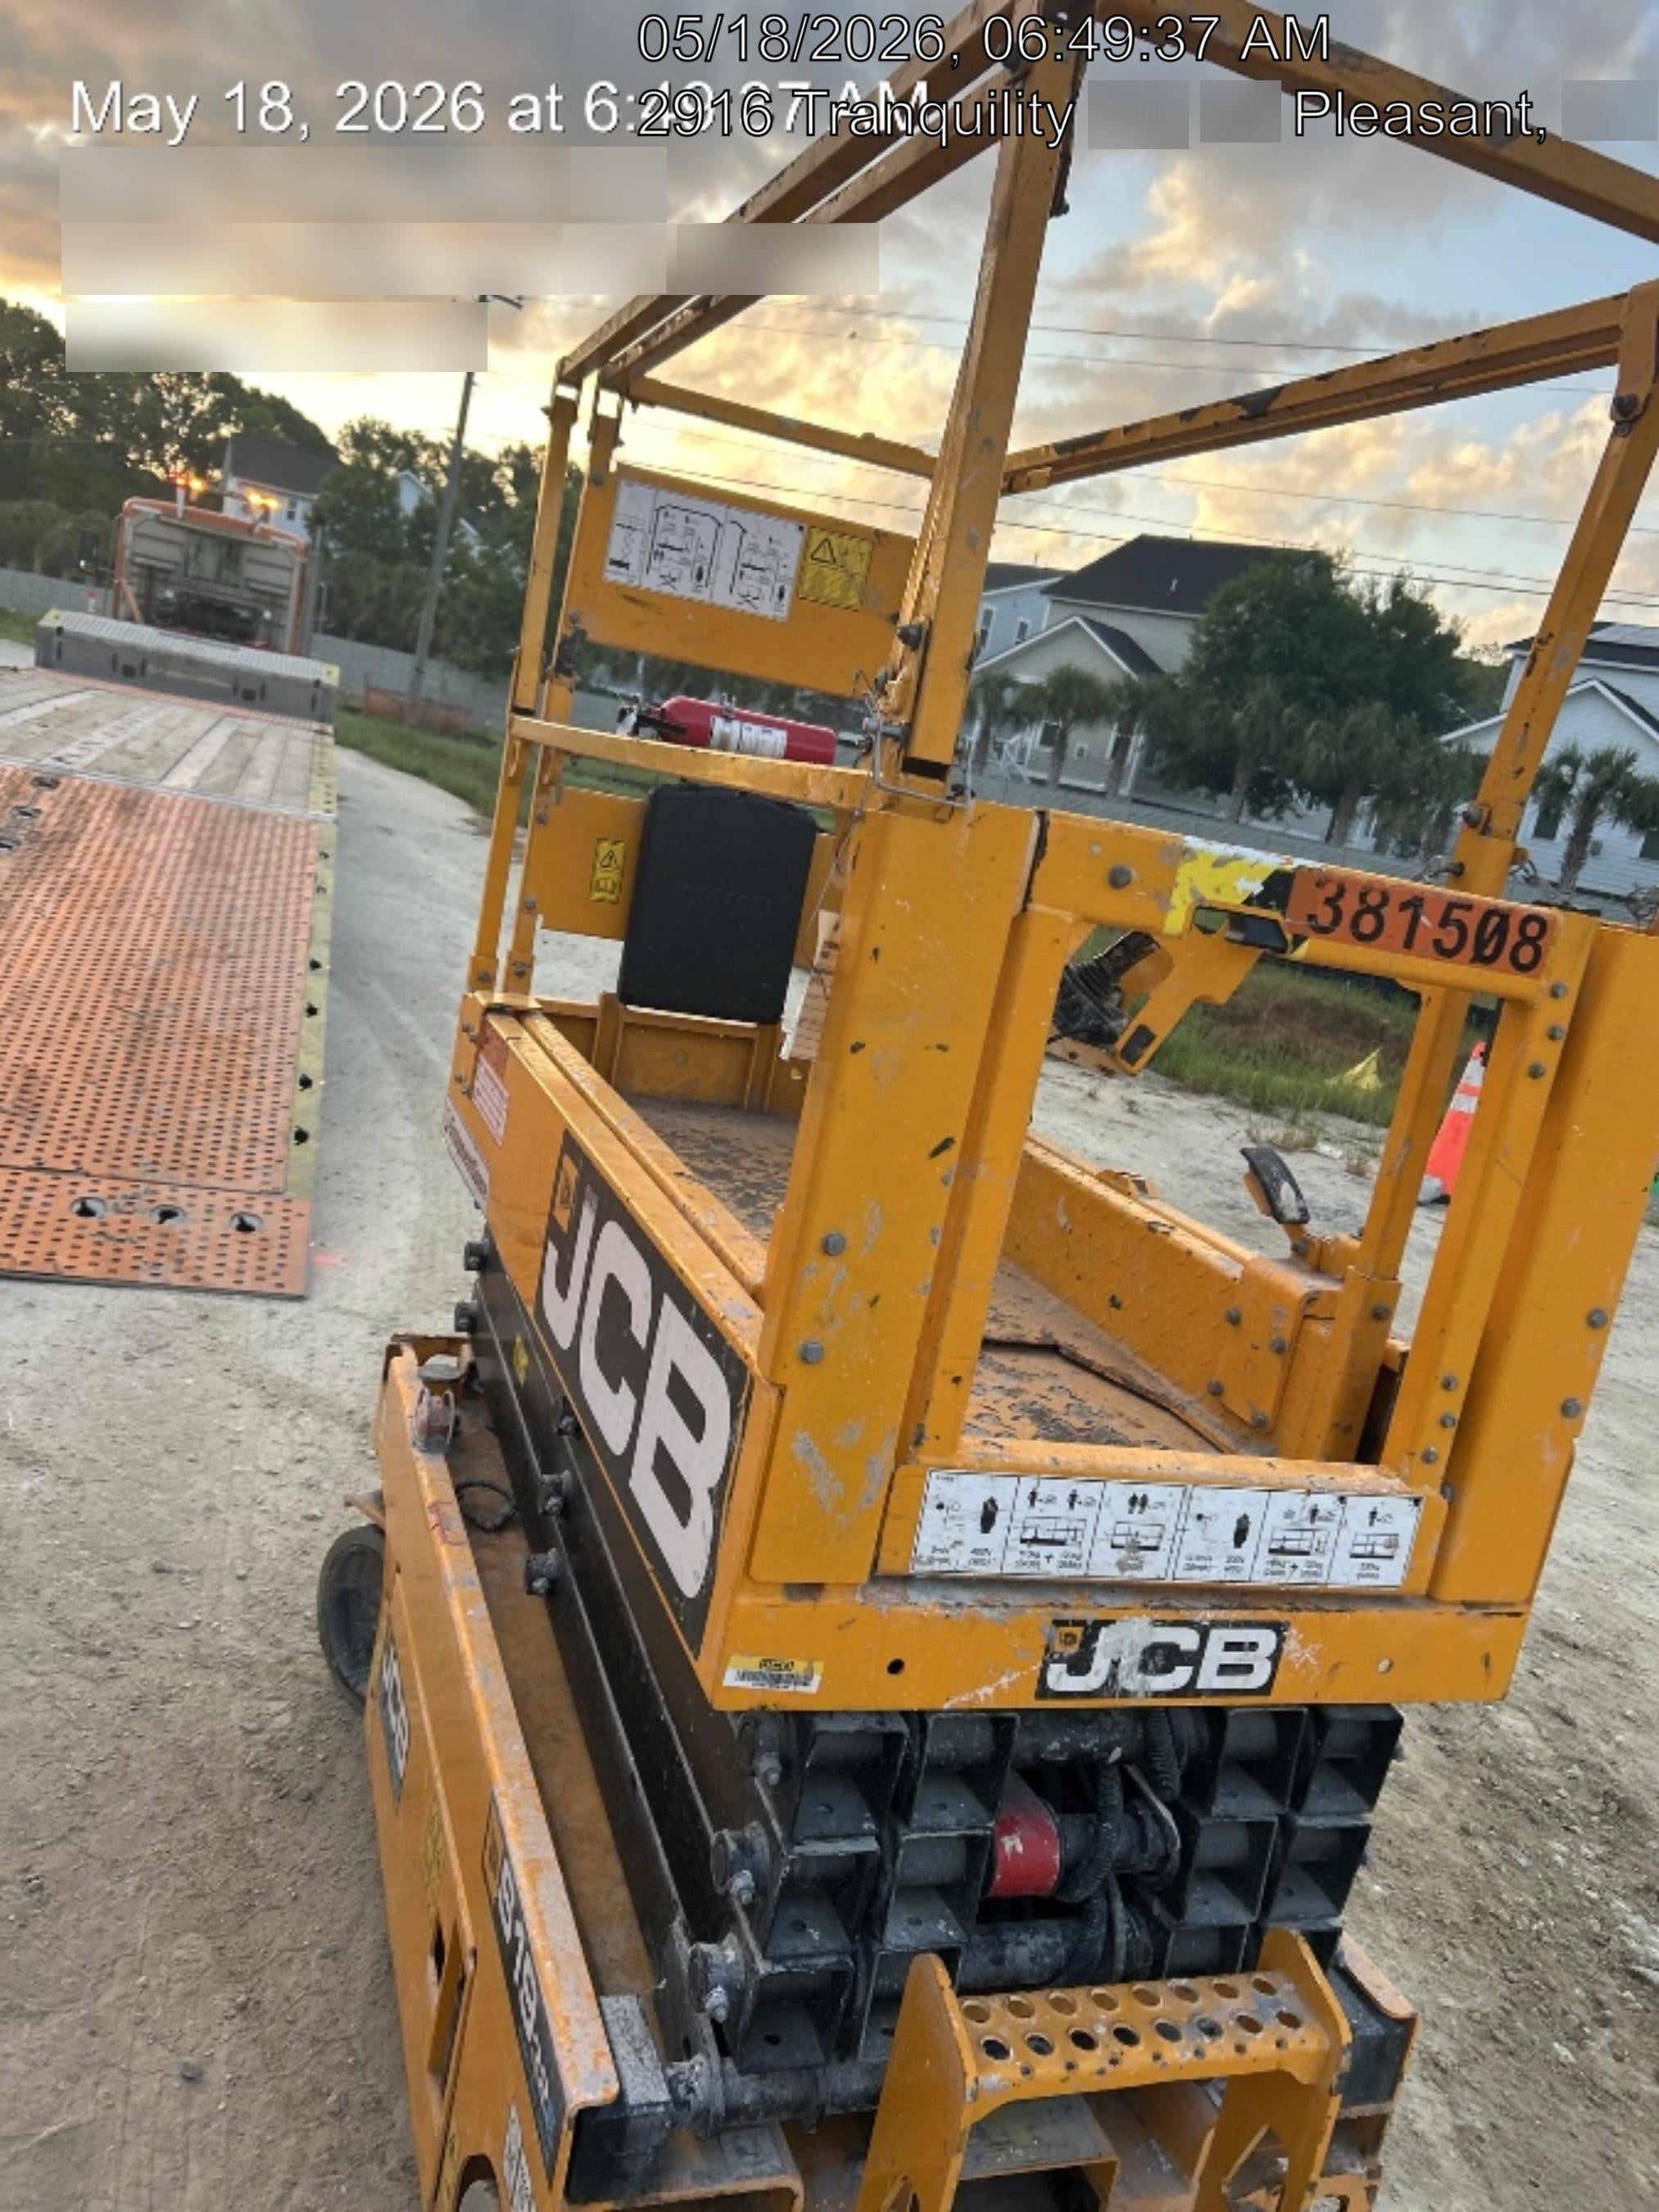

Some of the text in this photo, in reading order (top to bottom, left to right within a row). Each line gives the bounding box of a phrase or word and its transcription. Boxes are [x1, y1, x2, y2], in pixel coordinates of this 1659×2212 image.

[1306, 877, 1548, 973] 381508
[542, 1185, 731, 1599] JCB
[1047, 1626, 1276, 1693] JCB
